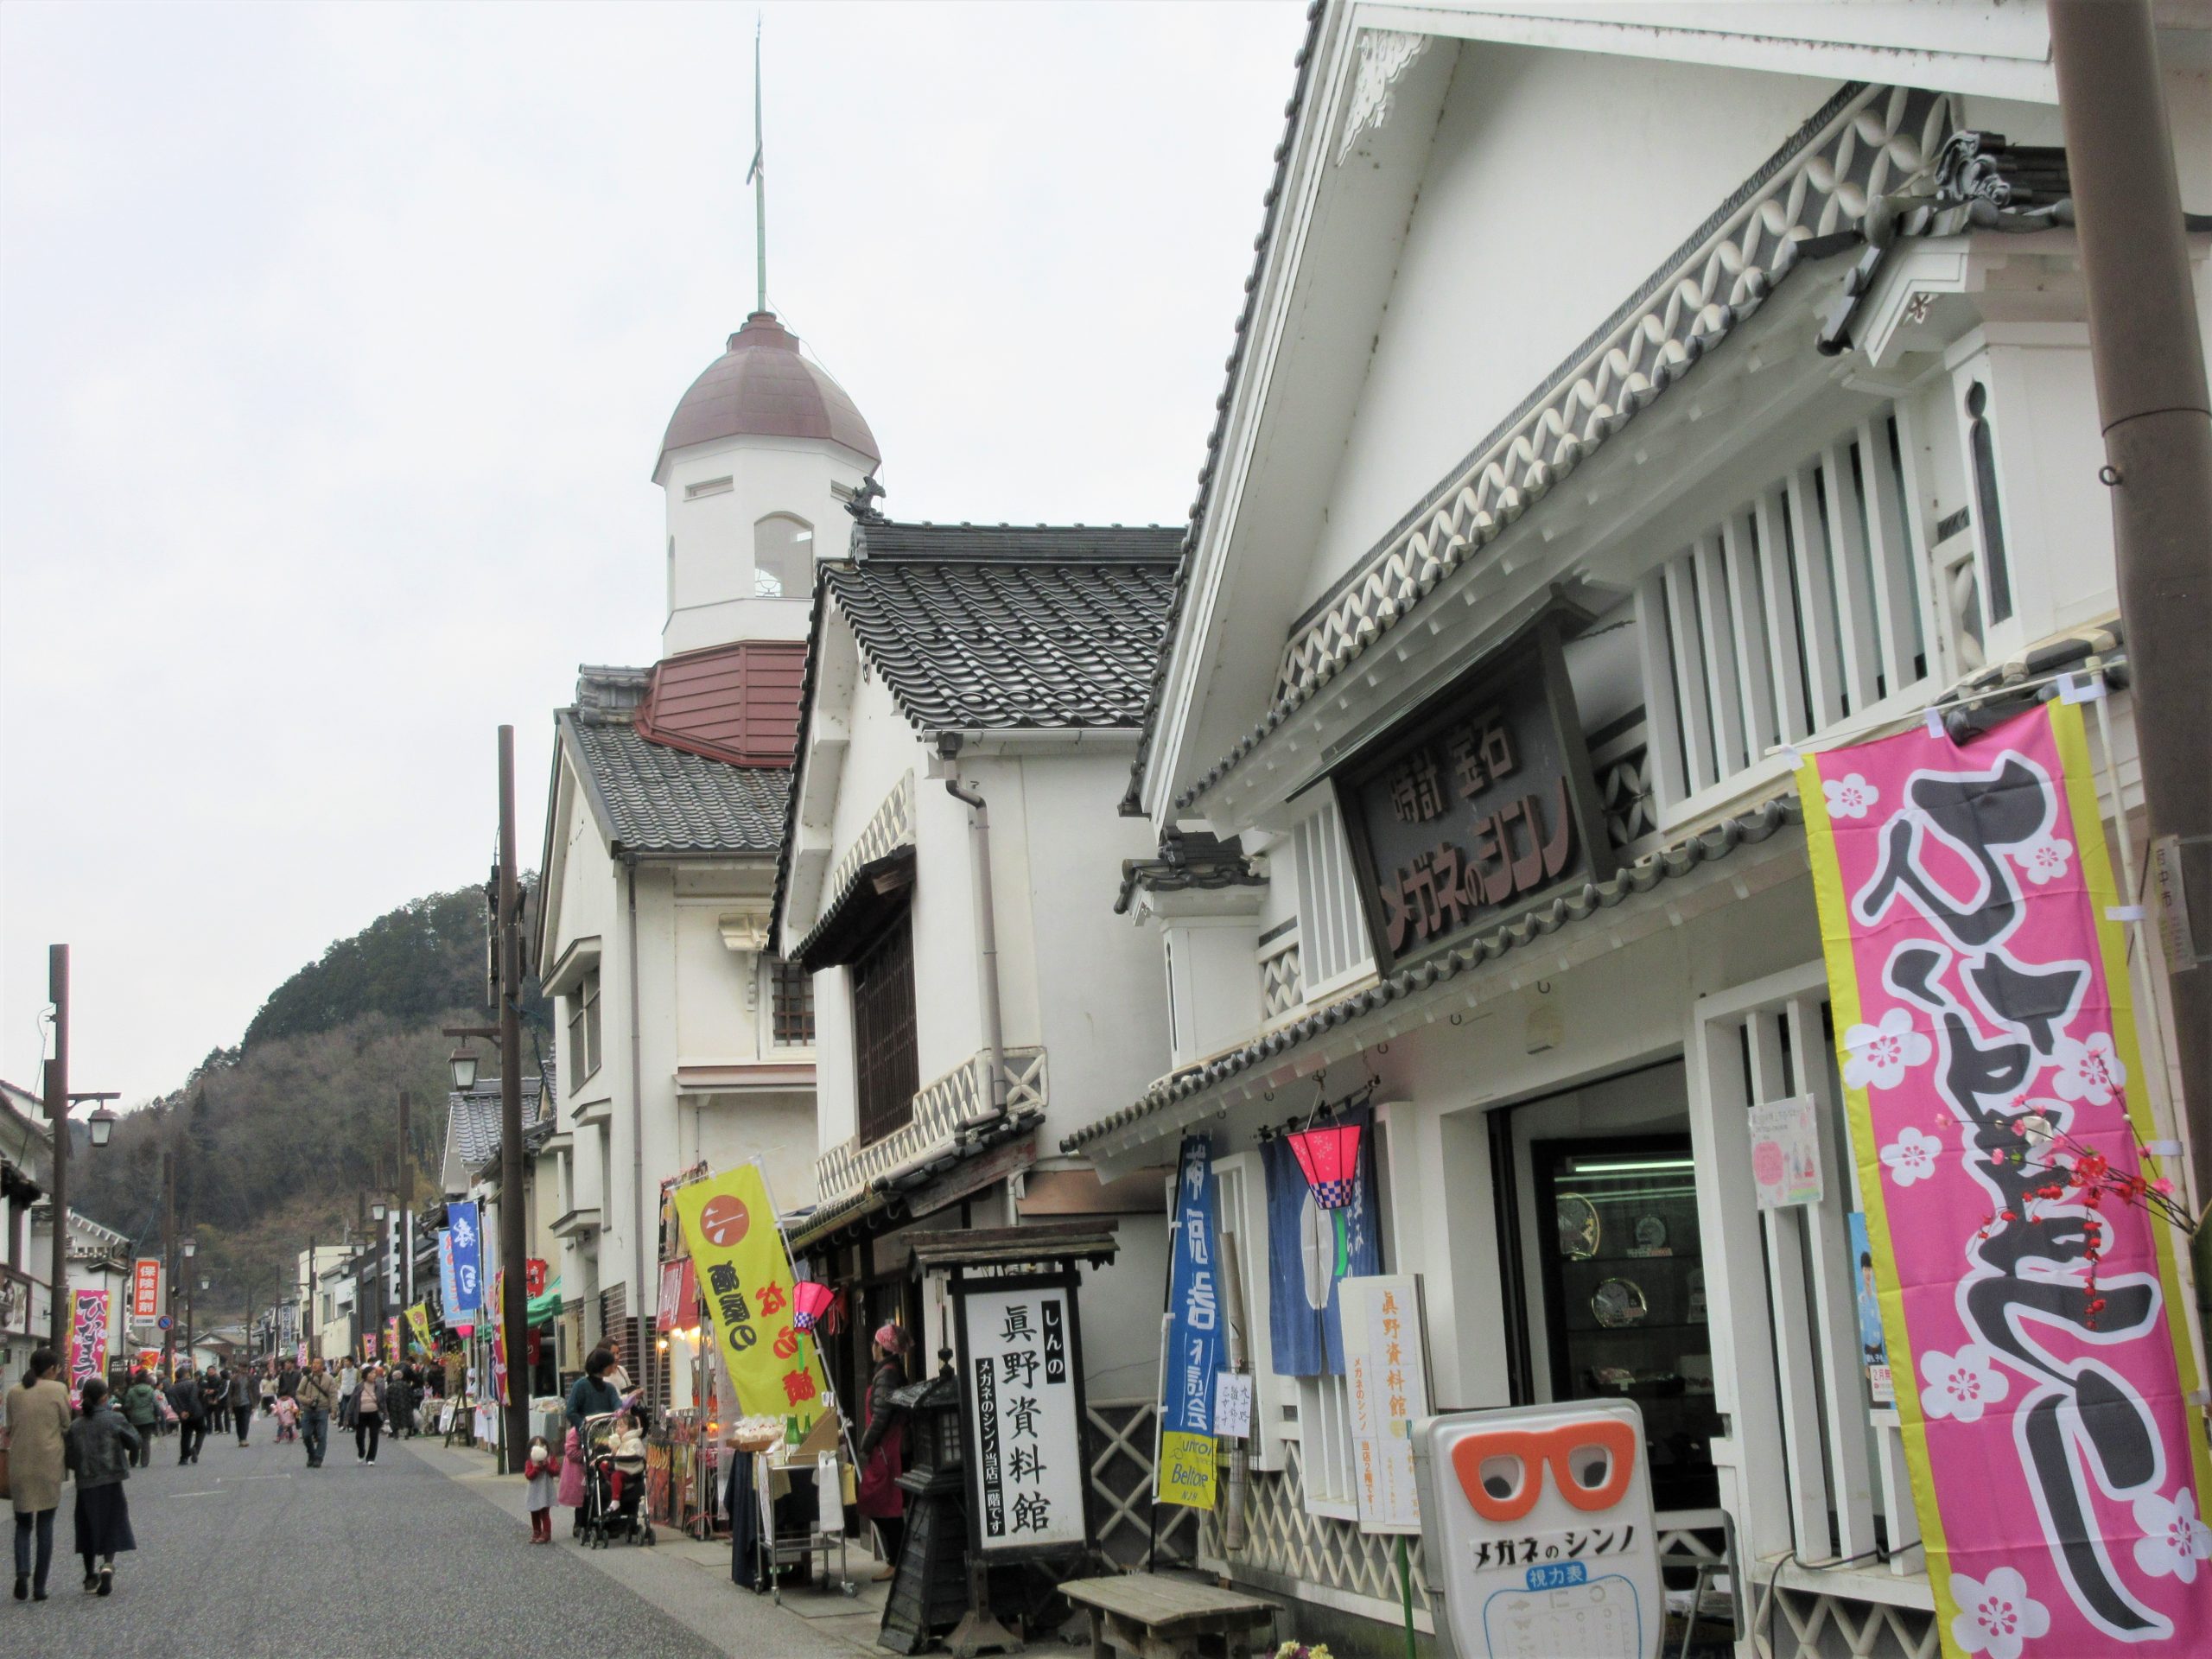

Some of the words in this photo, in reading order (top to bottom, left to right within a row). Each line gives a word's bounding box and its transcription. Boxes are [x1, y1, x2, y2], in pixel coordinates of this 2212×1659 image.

[1389, 748, 1446, 824] 時計
[1379, 776, 1570, 952] メガネのシンノ
[139, 1265, 156, 1313] 保険調剤
[1045, 1308, 1065, 1375] しんの
[1381, 1290, 1407, 1418] 眞野資料館
[999, 1304, 1052, 1535] 眞野資料館
[1353, 1357, 1367, 1431] メガネのシンノ
[978, 1359, 1003, 1535] メガネのシンノ当店二階です
[1474, 1525, 1634, 1570] メガネのシンノ
[1529, 1565, 1583, 1588] 視力表
